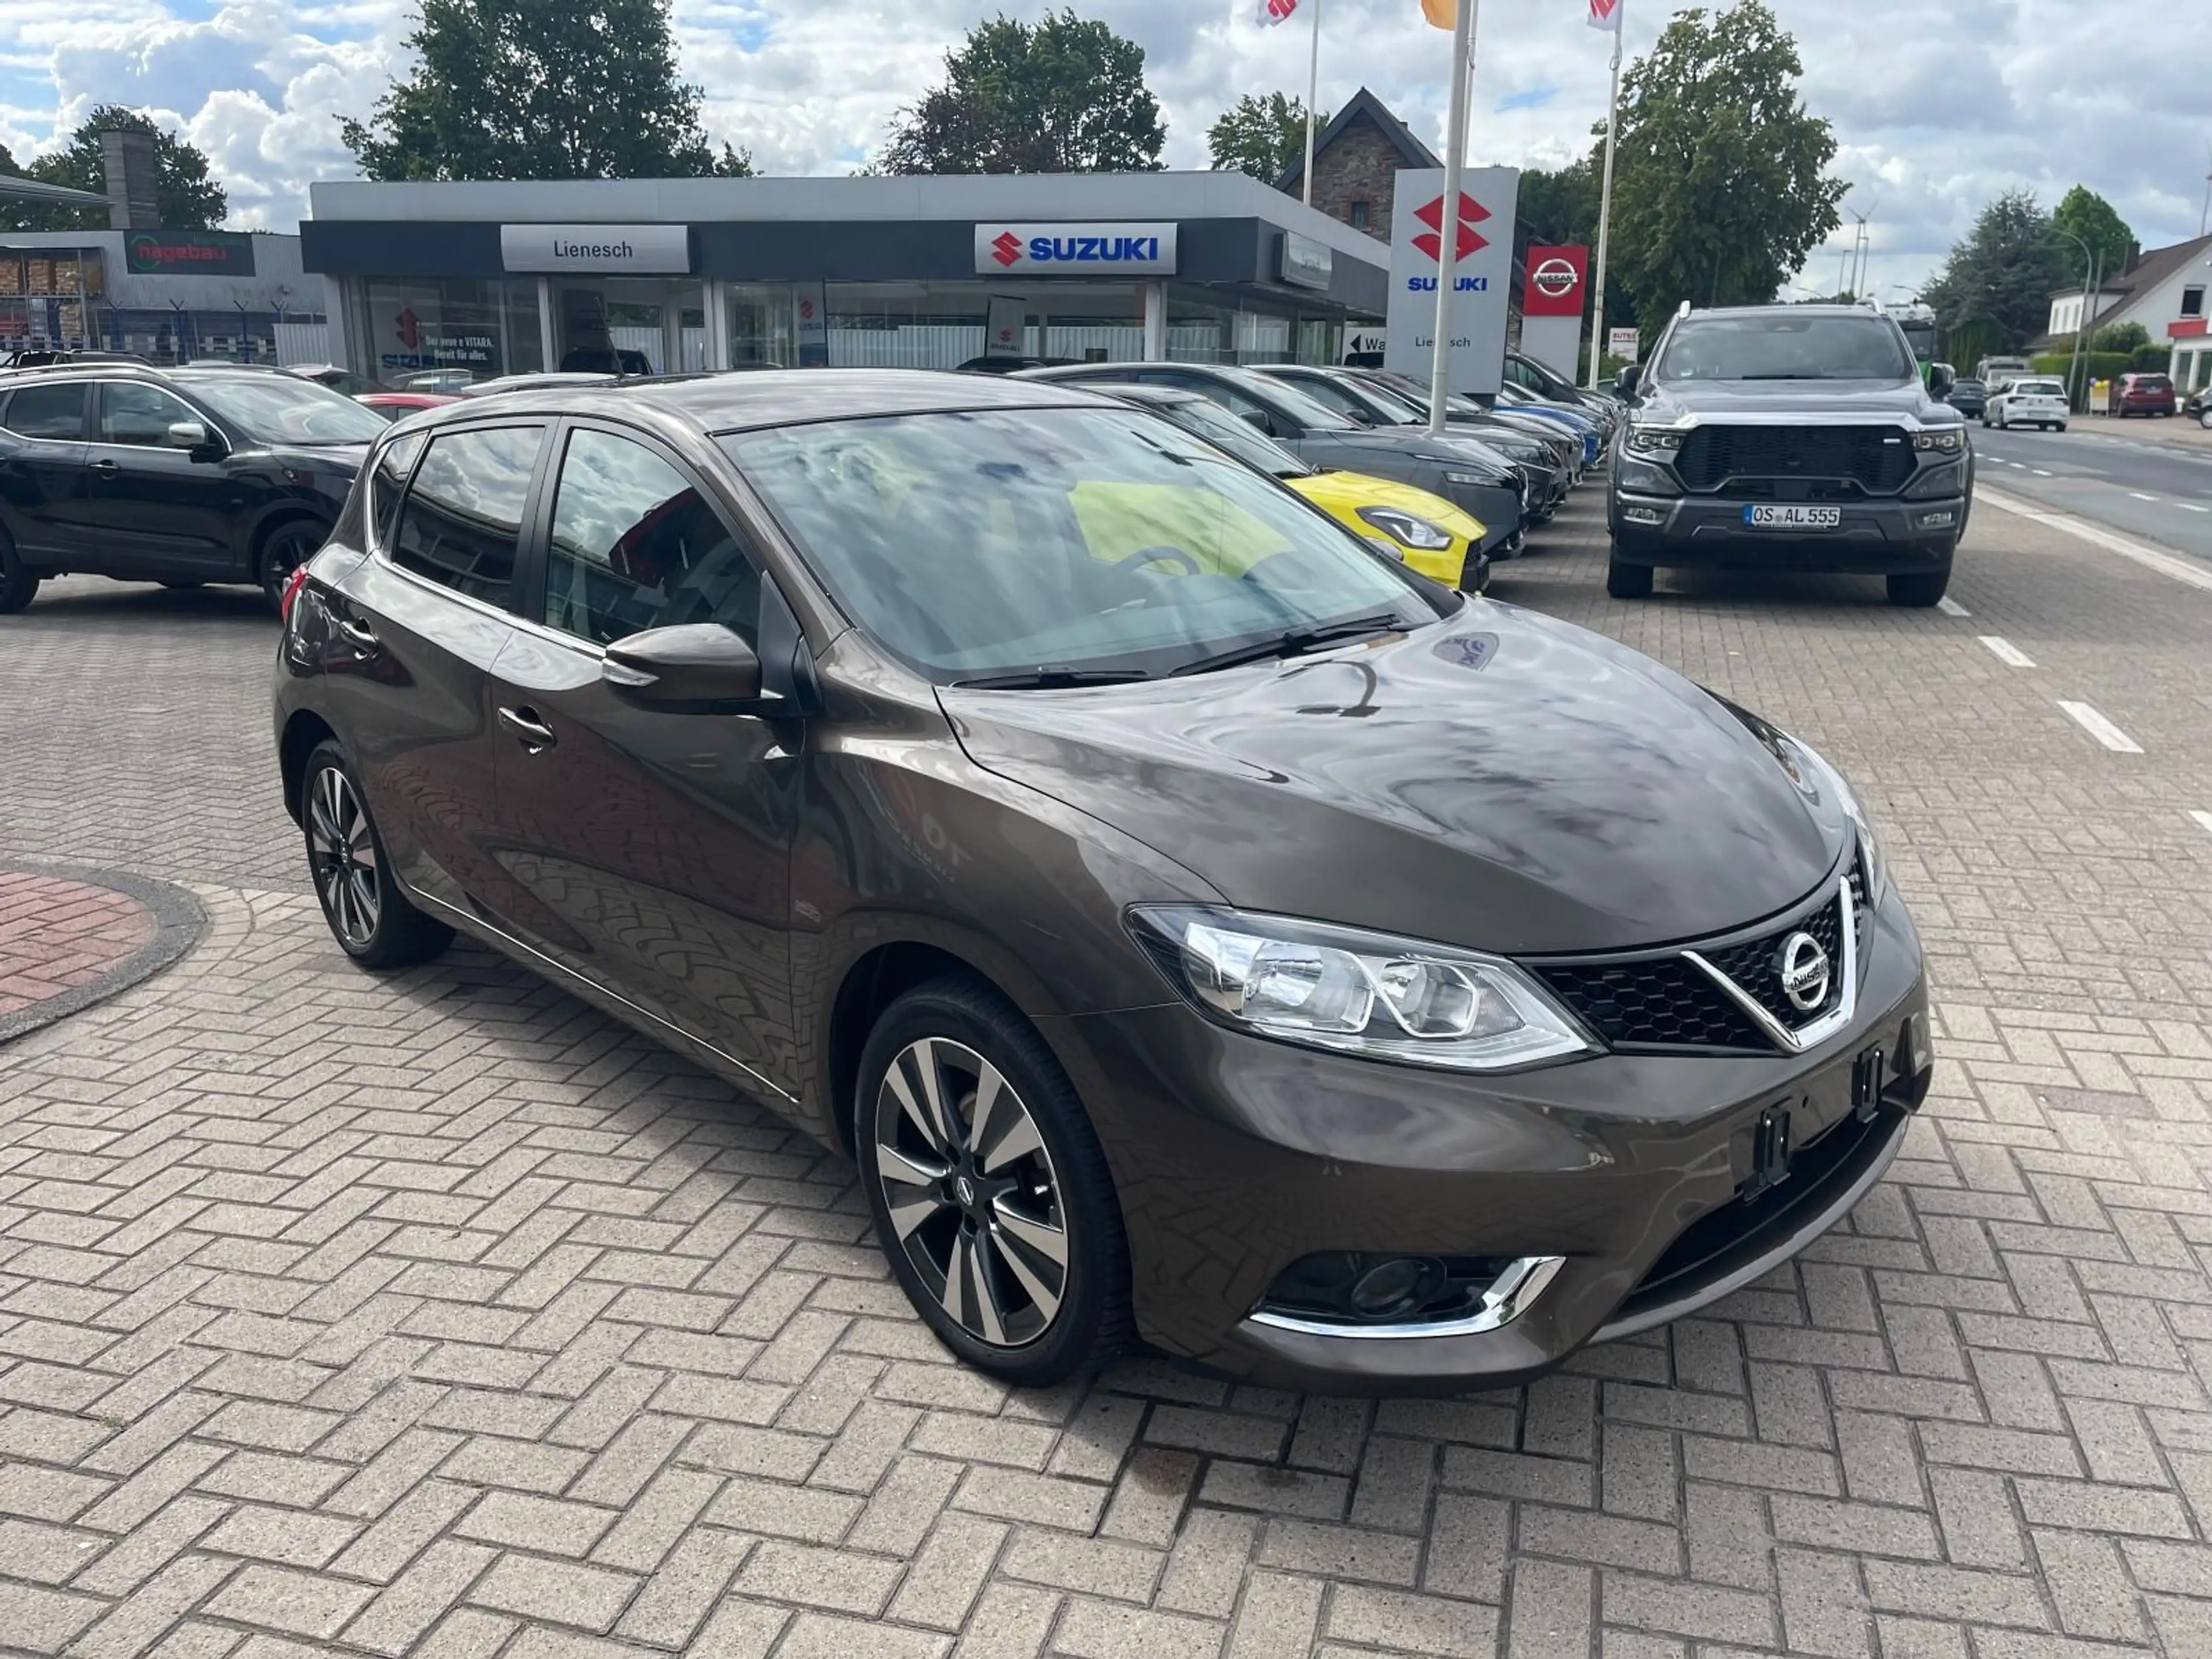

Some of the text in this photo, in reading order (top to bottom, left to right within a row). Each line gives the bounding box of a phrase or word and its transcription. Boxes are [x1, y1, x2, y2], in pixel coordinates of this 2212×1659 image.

[138, 244, 226, 262] hagebau
[554, 240, 632, 257] Lienesch
[1029, 238, 1158, 260] SUZUKI
[1407, 278, 1487, 291] SUUKI
[1415, 336, 1471, 347] Liesch
[1754, 507, 1838, 524] OS AL 555
